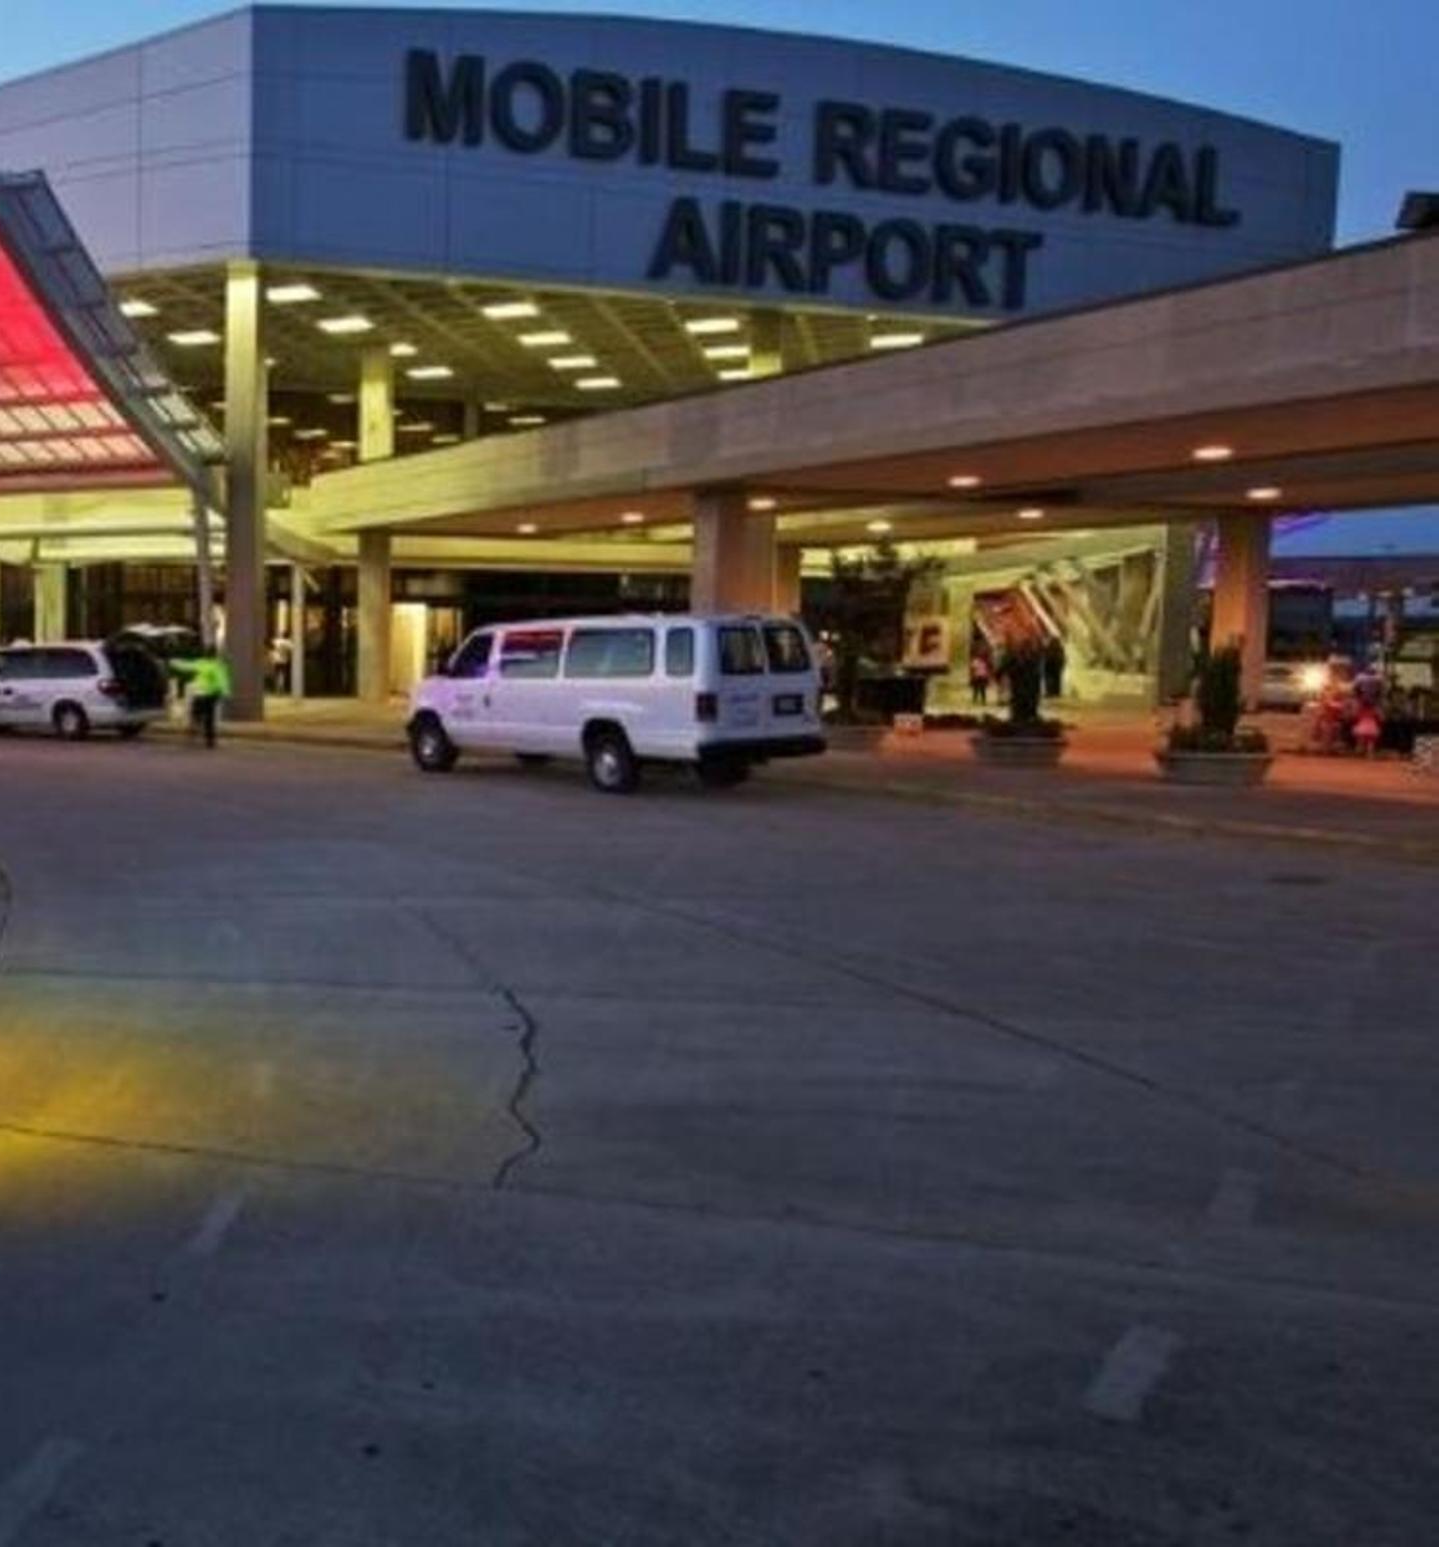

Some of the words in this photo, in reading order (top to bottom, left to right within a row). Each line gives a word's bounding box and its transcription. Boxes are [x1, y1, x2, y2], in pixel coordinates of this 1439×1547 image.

[404, 47, 780, 181] MOBILE
[813, 101, 1241, 228] REGIONAL
[647, 196, 1043, 311] AIRPORT
